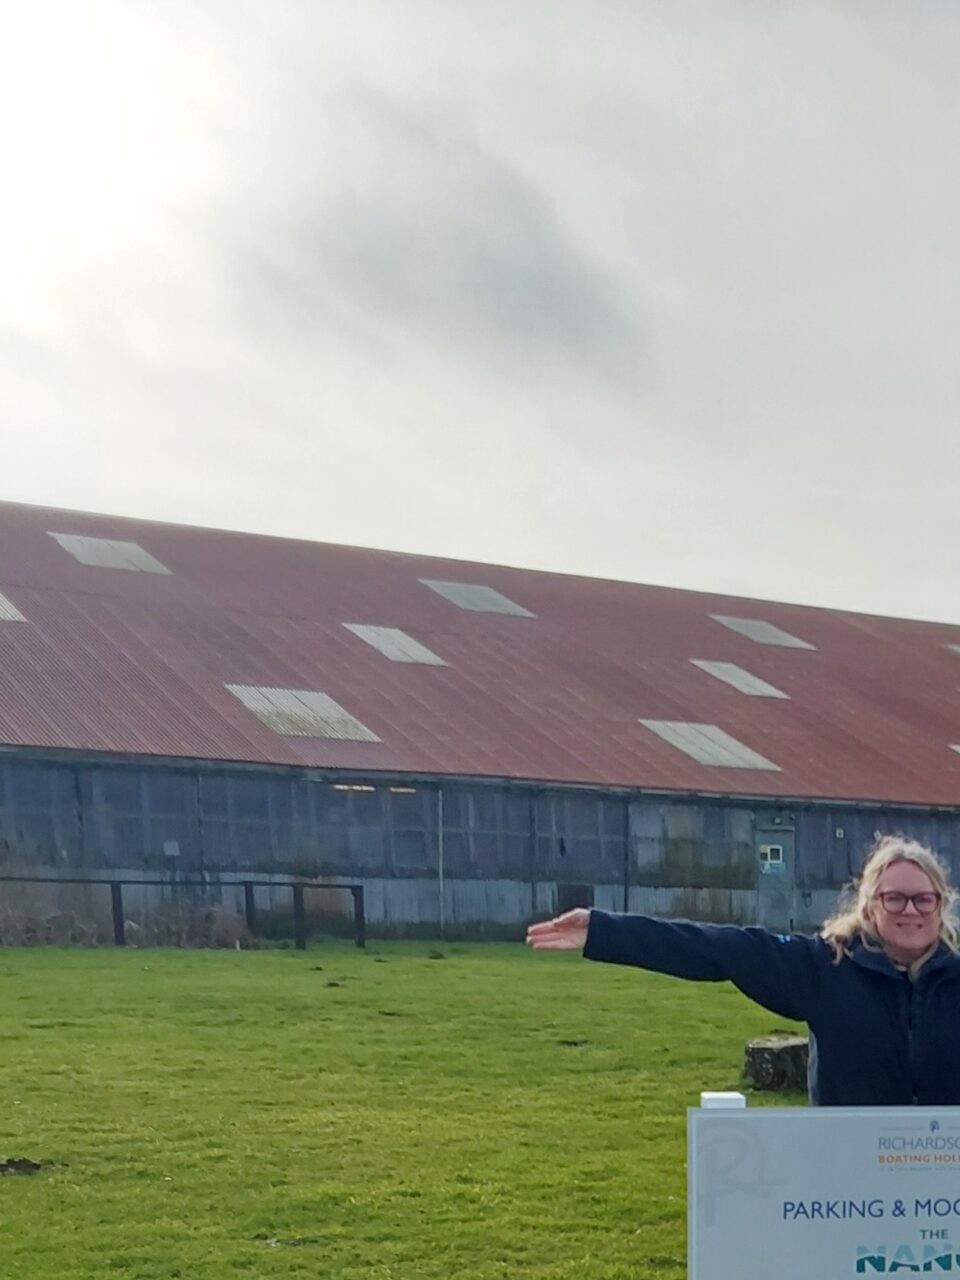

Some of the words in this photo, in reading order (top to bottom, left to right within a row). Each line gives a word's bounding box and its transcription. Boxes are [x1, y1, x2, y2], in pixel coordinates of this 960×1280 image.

[878, 1154, 930, 1164] BOATING
[783, 1200, 884, 1220] PARKING
[892, 1199, 906, 1217] &
[920, 1229, 949, 1240] THE
